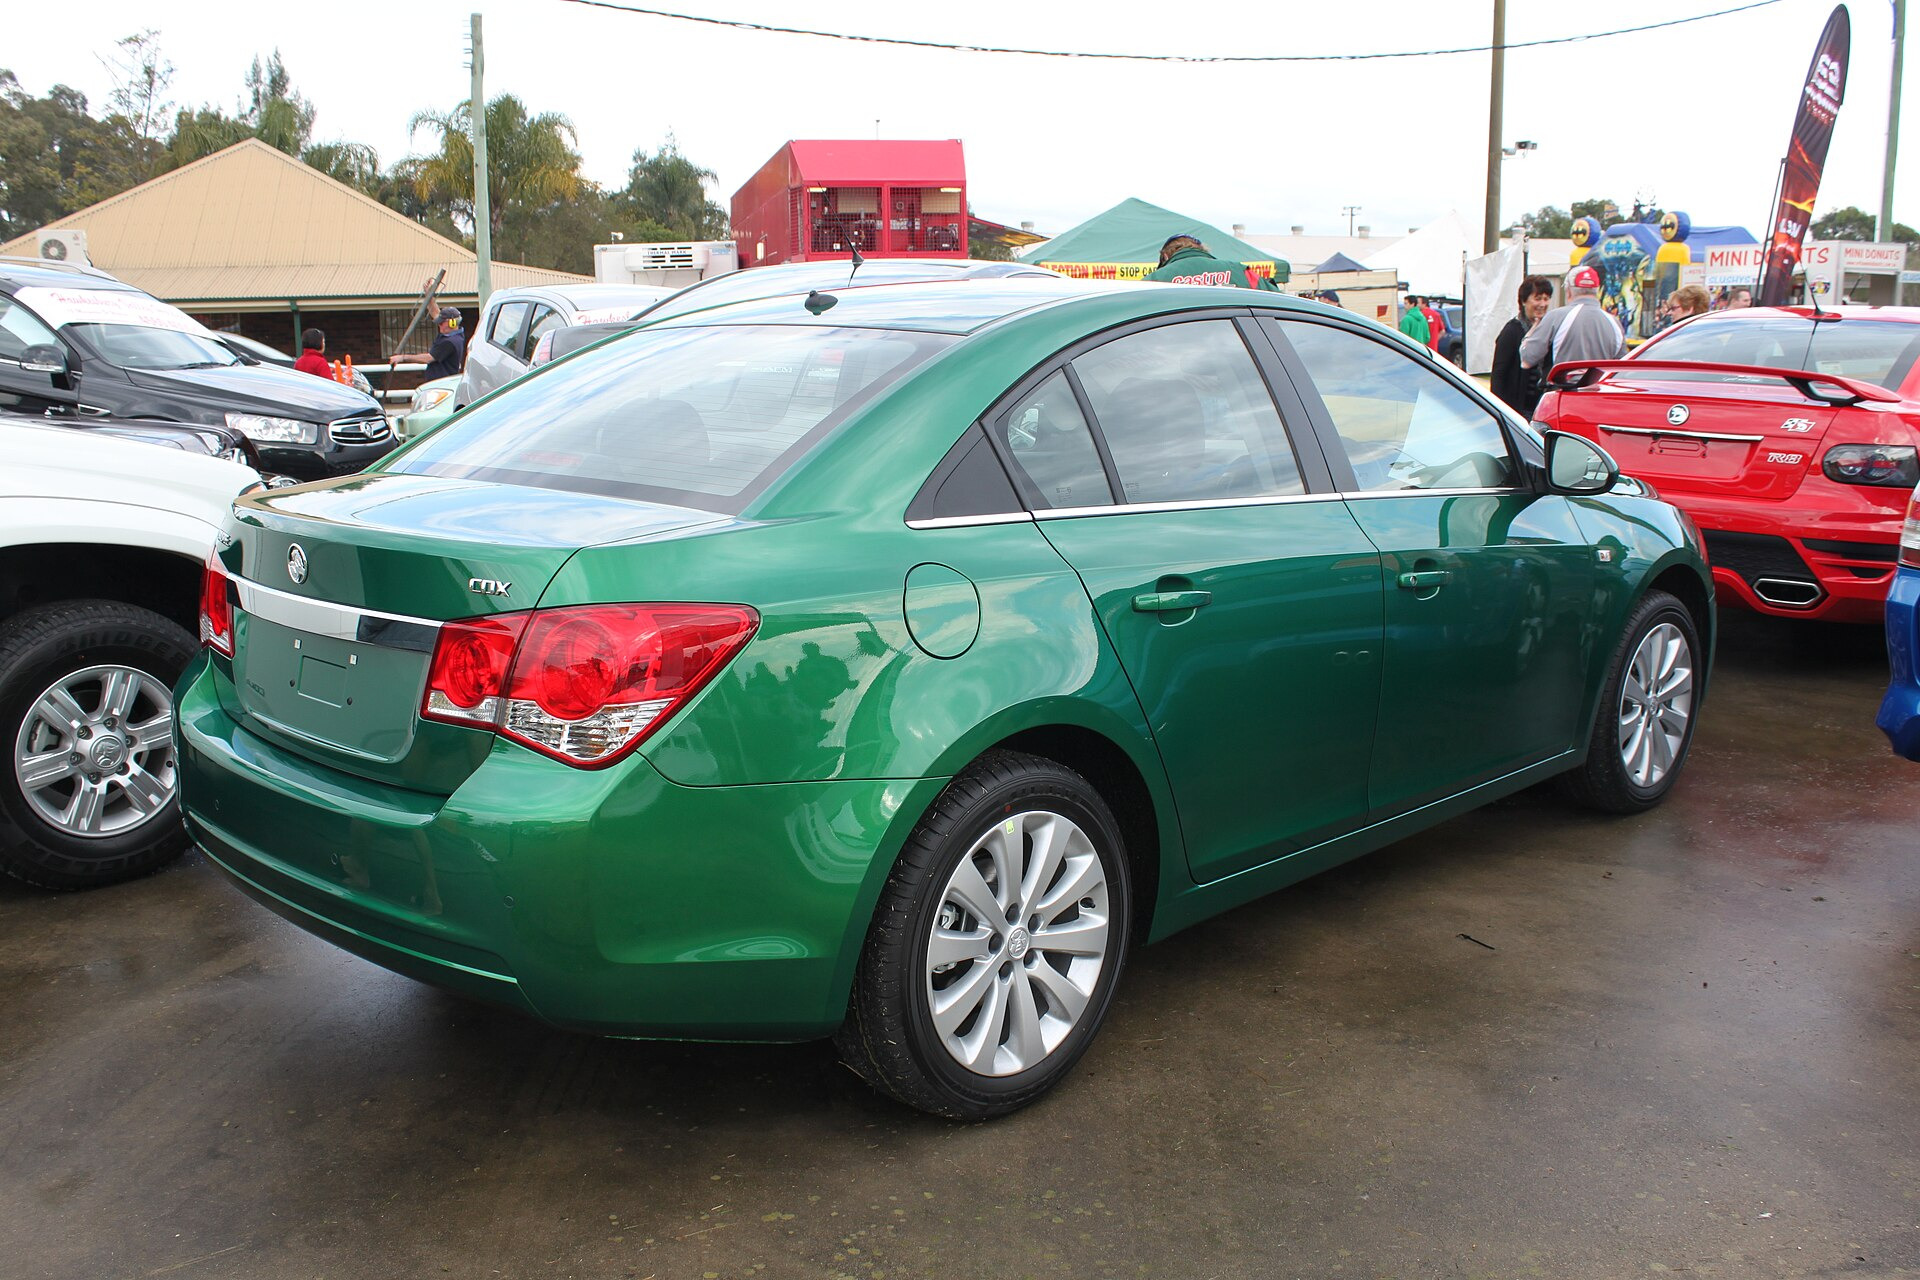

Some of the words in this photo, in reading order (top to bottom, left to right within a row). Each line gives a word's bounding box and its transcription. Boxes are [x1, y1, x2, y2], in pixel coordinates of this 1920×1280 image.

[1710, 249, 1748, 267] MINI
[1754, 247, 1829, 266] DTS
[1844, 247, 1863, 258] MINI
[1865, 249, 1900, 260] DONUTS
[1092, 265, 1117, 280] NOW
[1120, 267, 1140, 277] STOP
[1767, 451, 1803, 465] R8
[468, 577, 512, 598] CDX
